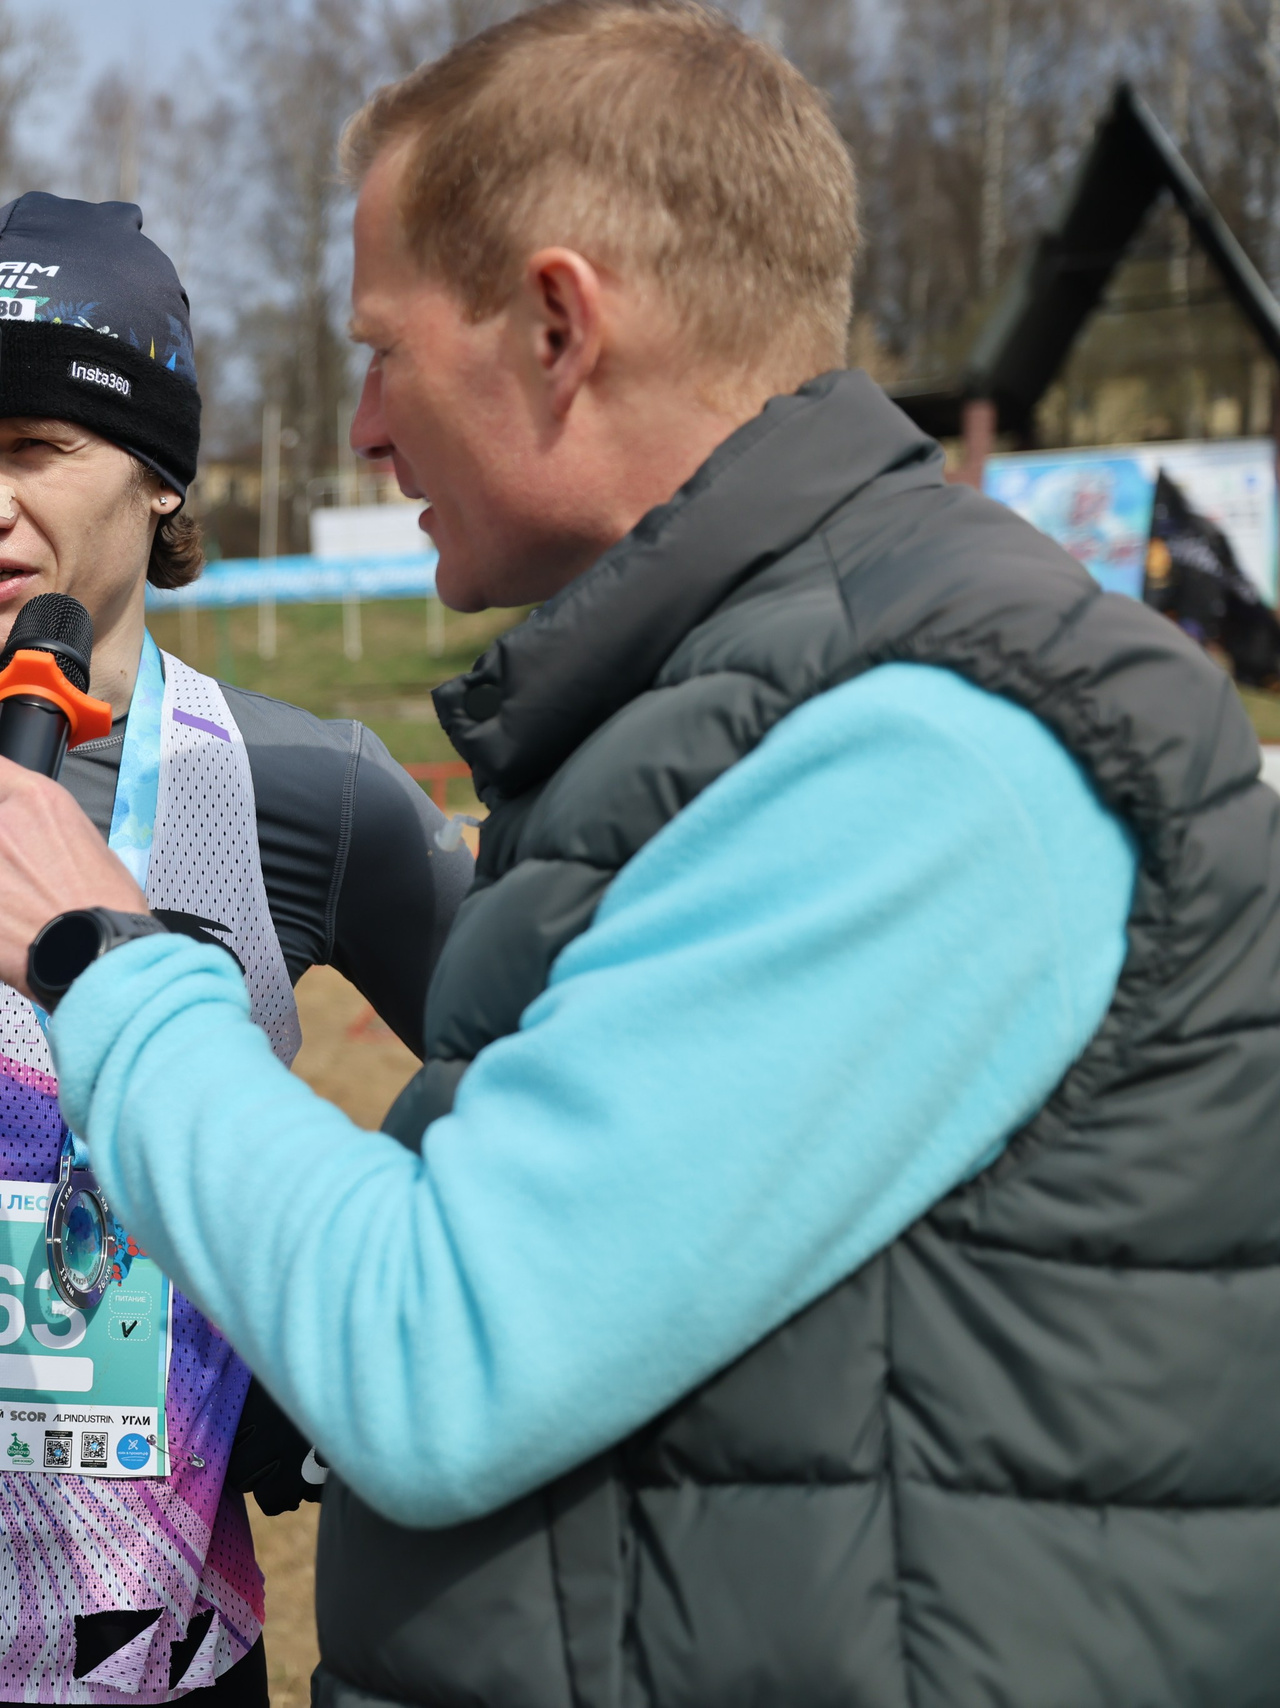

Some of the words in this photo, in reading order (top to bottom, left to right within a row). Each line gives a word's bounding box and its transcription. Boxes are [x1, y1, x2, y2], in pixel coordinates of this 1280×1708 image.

[71, 361, 129, 395] Insta360
[7, 1194, 50, 1212] ЛЕС
[115, 1295, 147, 1303] ПИТАНИЕ
[119, 1319, 142, 1327] НОСИ
[10, 1410, 47, 1422] SCOR
[53, 1413, 115, 1424] ALPINDUSTRIA
[121, 1415, 151, 1426] УГЛИ
